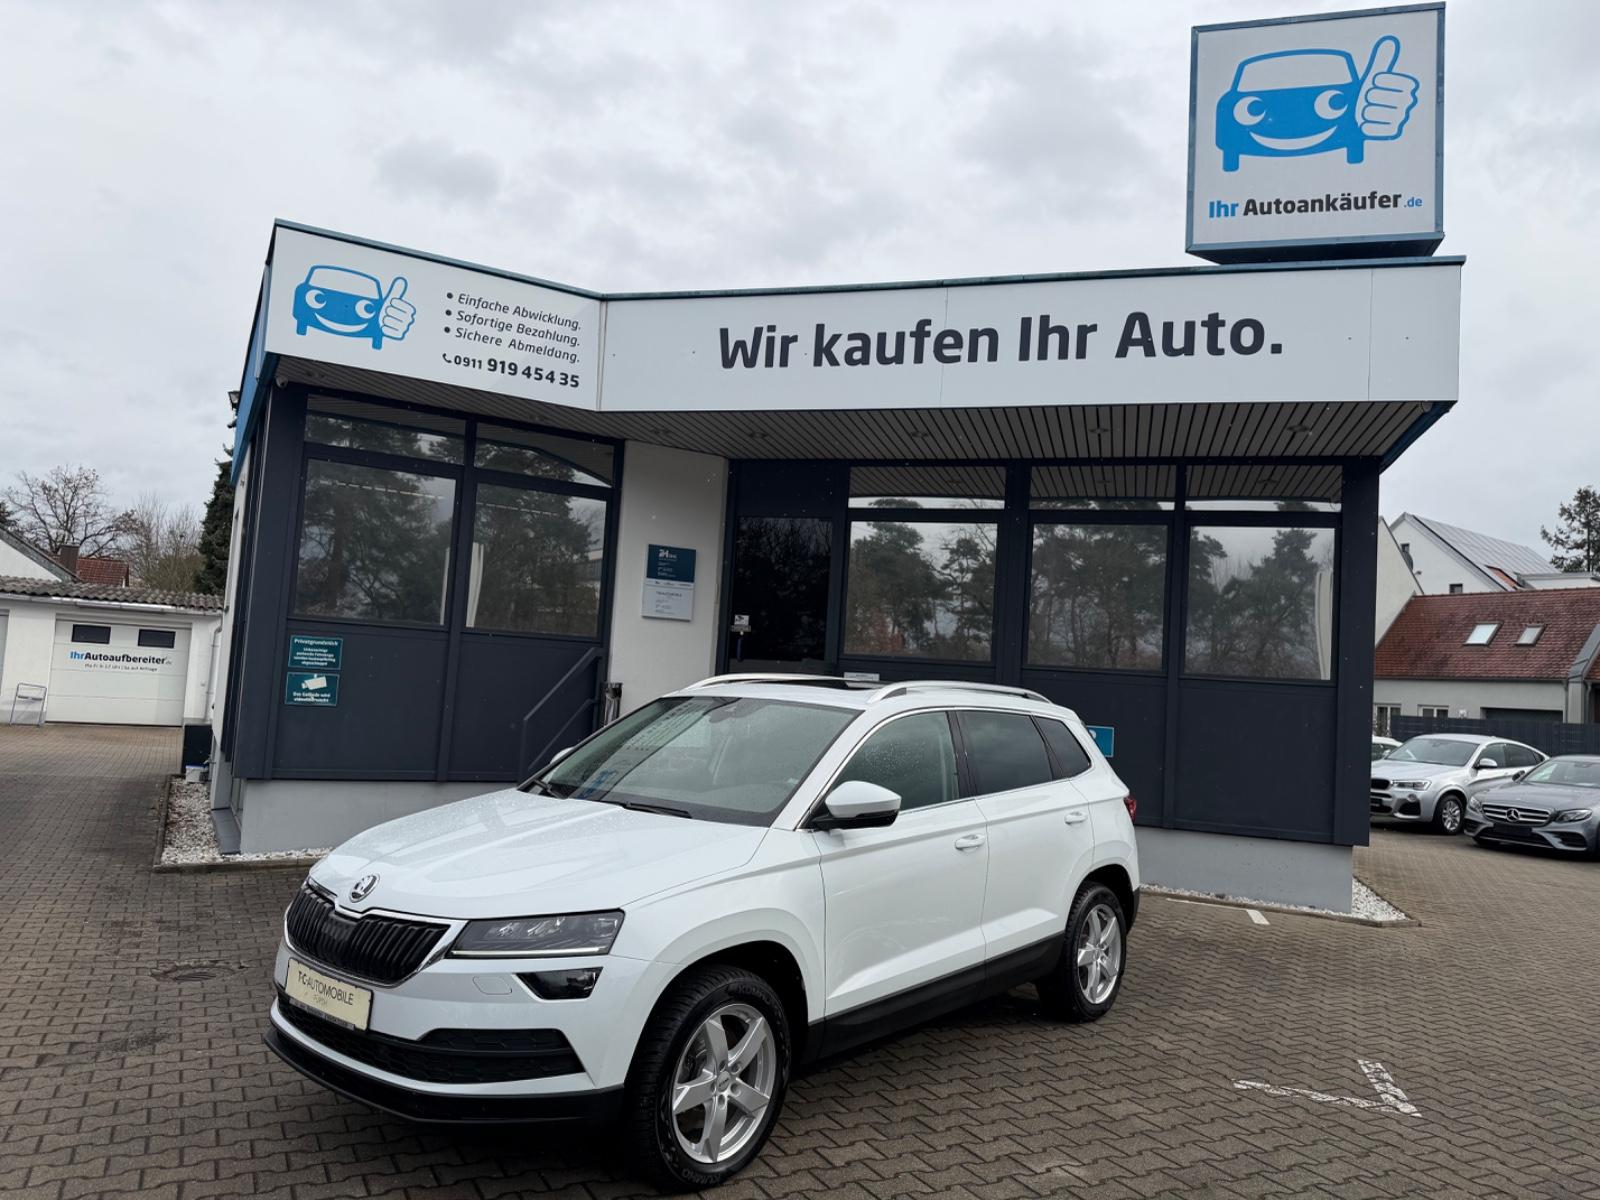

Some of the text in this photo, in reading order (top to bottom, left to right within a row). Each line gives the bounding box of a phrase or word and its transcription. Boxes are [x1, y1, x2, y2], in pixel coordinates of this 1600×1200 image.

[1209, 200, 1239, 218] Ihr
[456, 310, 580, 347] Sofortige Bezahlung.
[458, 293, 582, 331] Einfache Abwicklung.
[455, 326, 580, 364] Sichere Abmeldung.
[719, 311, 1283, 369] Wir kaufen Ihr Auto.
[453, 355, 483, 370] 0911
